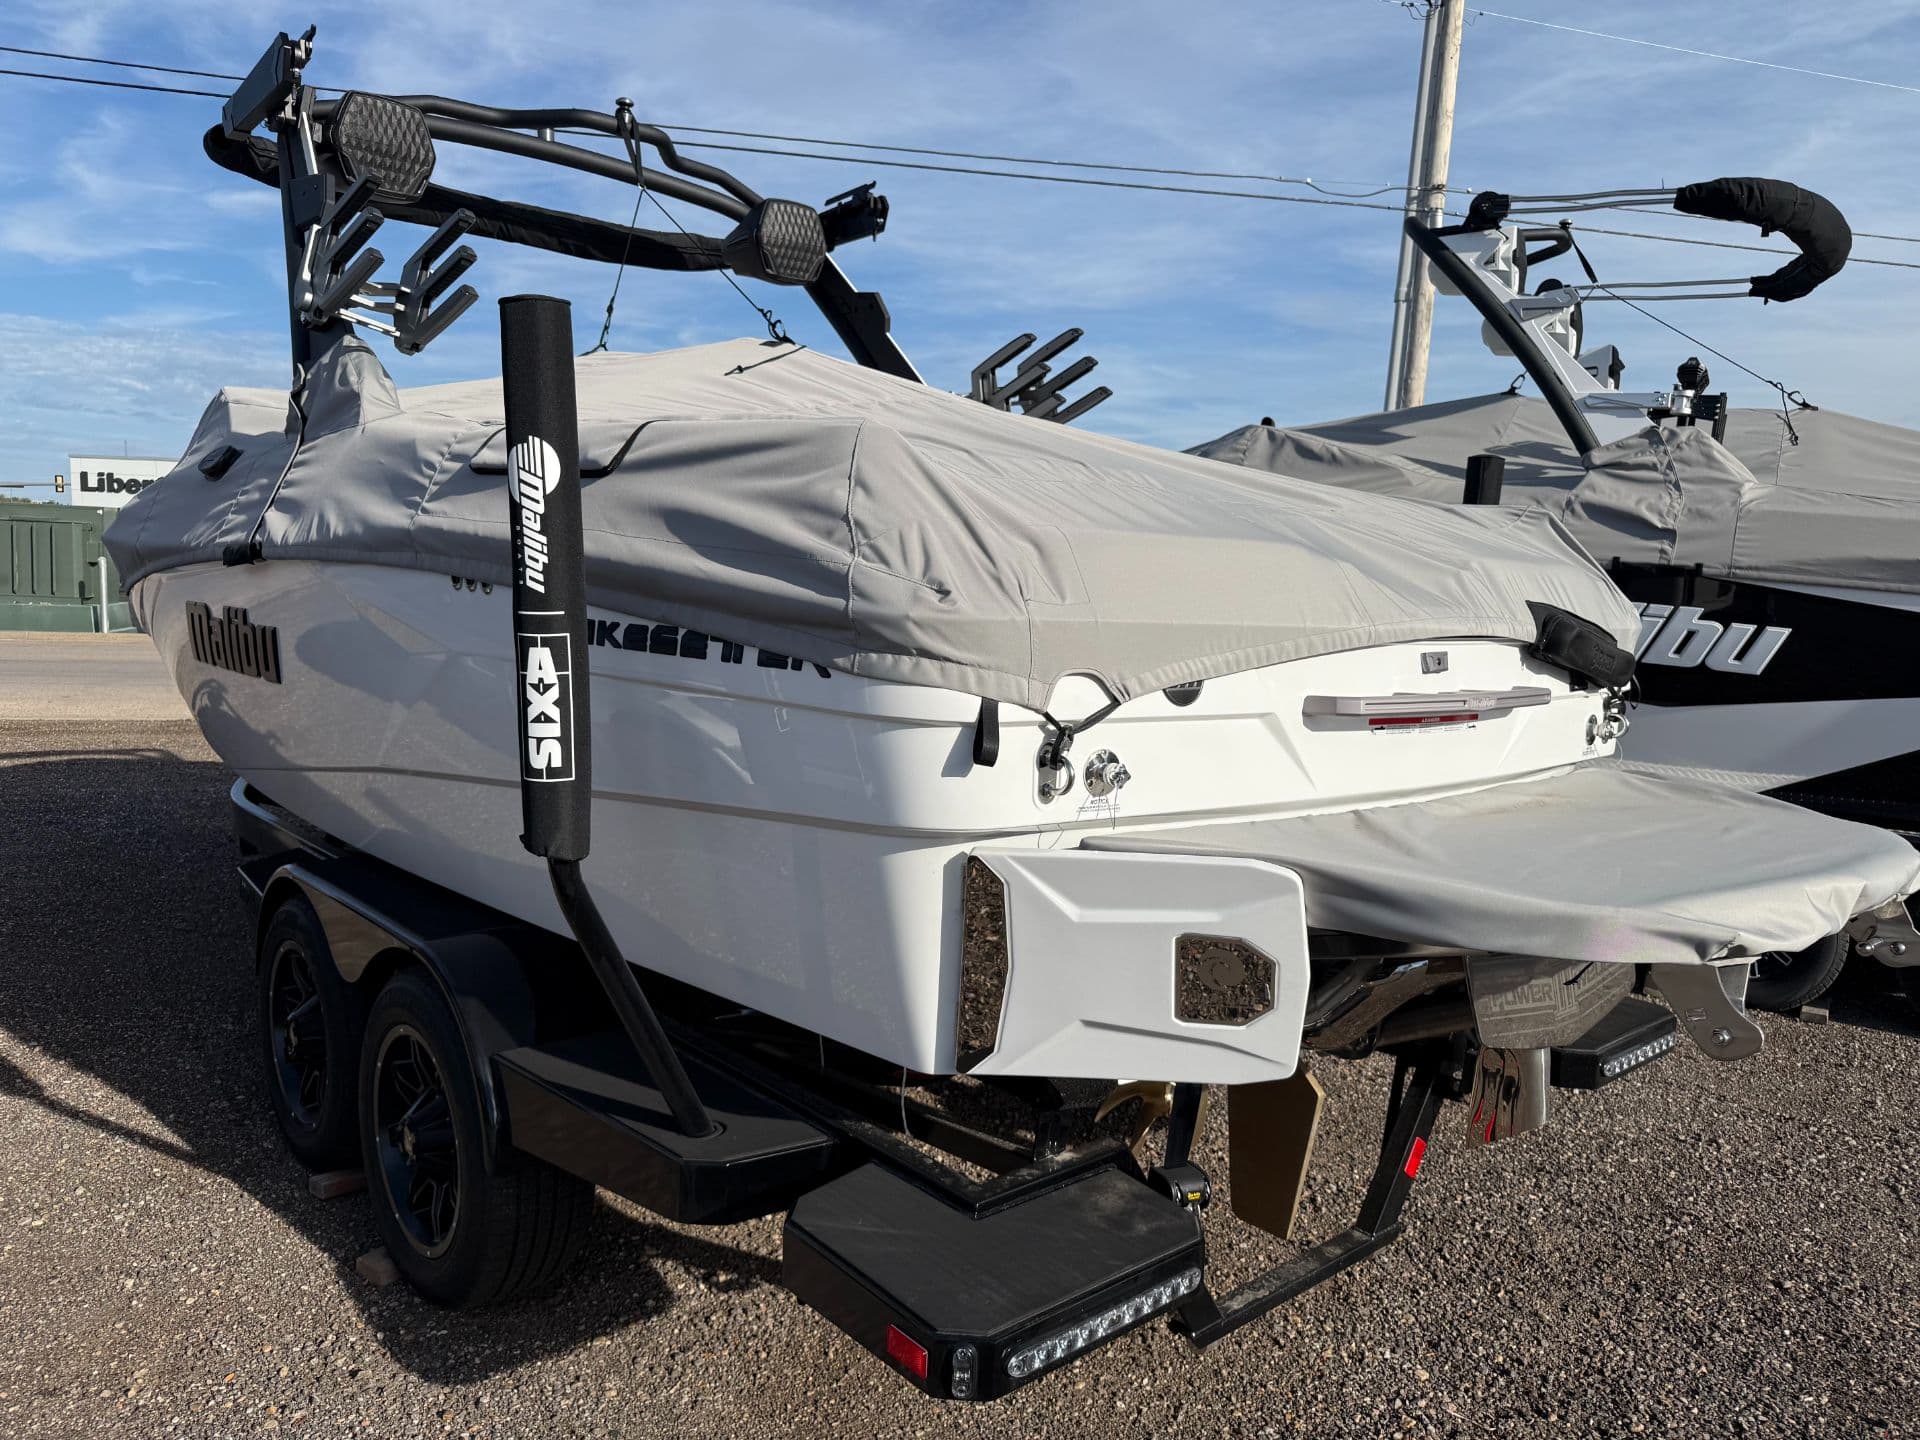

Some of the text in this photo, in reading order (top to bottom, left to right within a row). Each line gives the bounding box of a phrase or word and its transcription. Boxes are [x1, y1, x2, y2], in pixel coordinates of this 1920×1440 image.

[79, 470, 165, 495] Liber
[518, 467, 549, 594] Malibu
[185, 600, 282, 685] Malibu
[587, 619, 832, 679] KESETTE
[1631, 601, 1793, 676] ibu
[526, 646, 562, 770] AXIS
